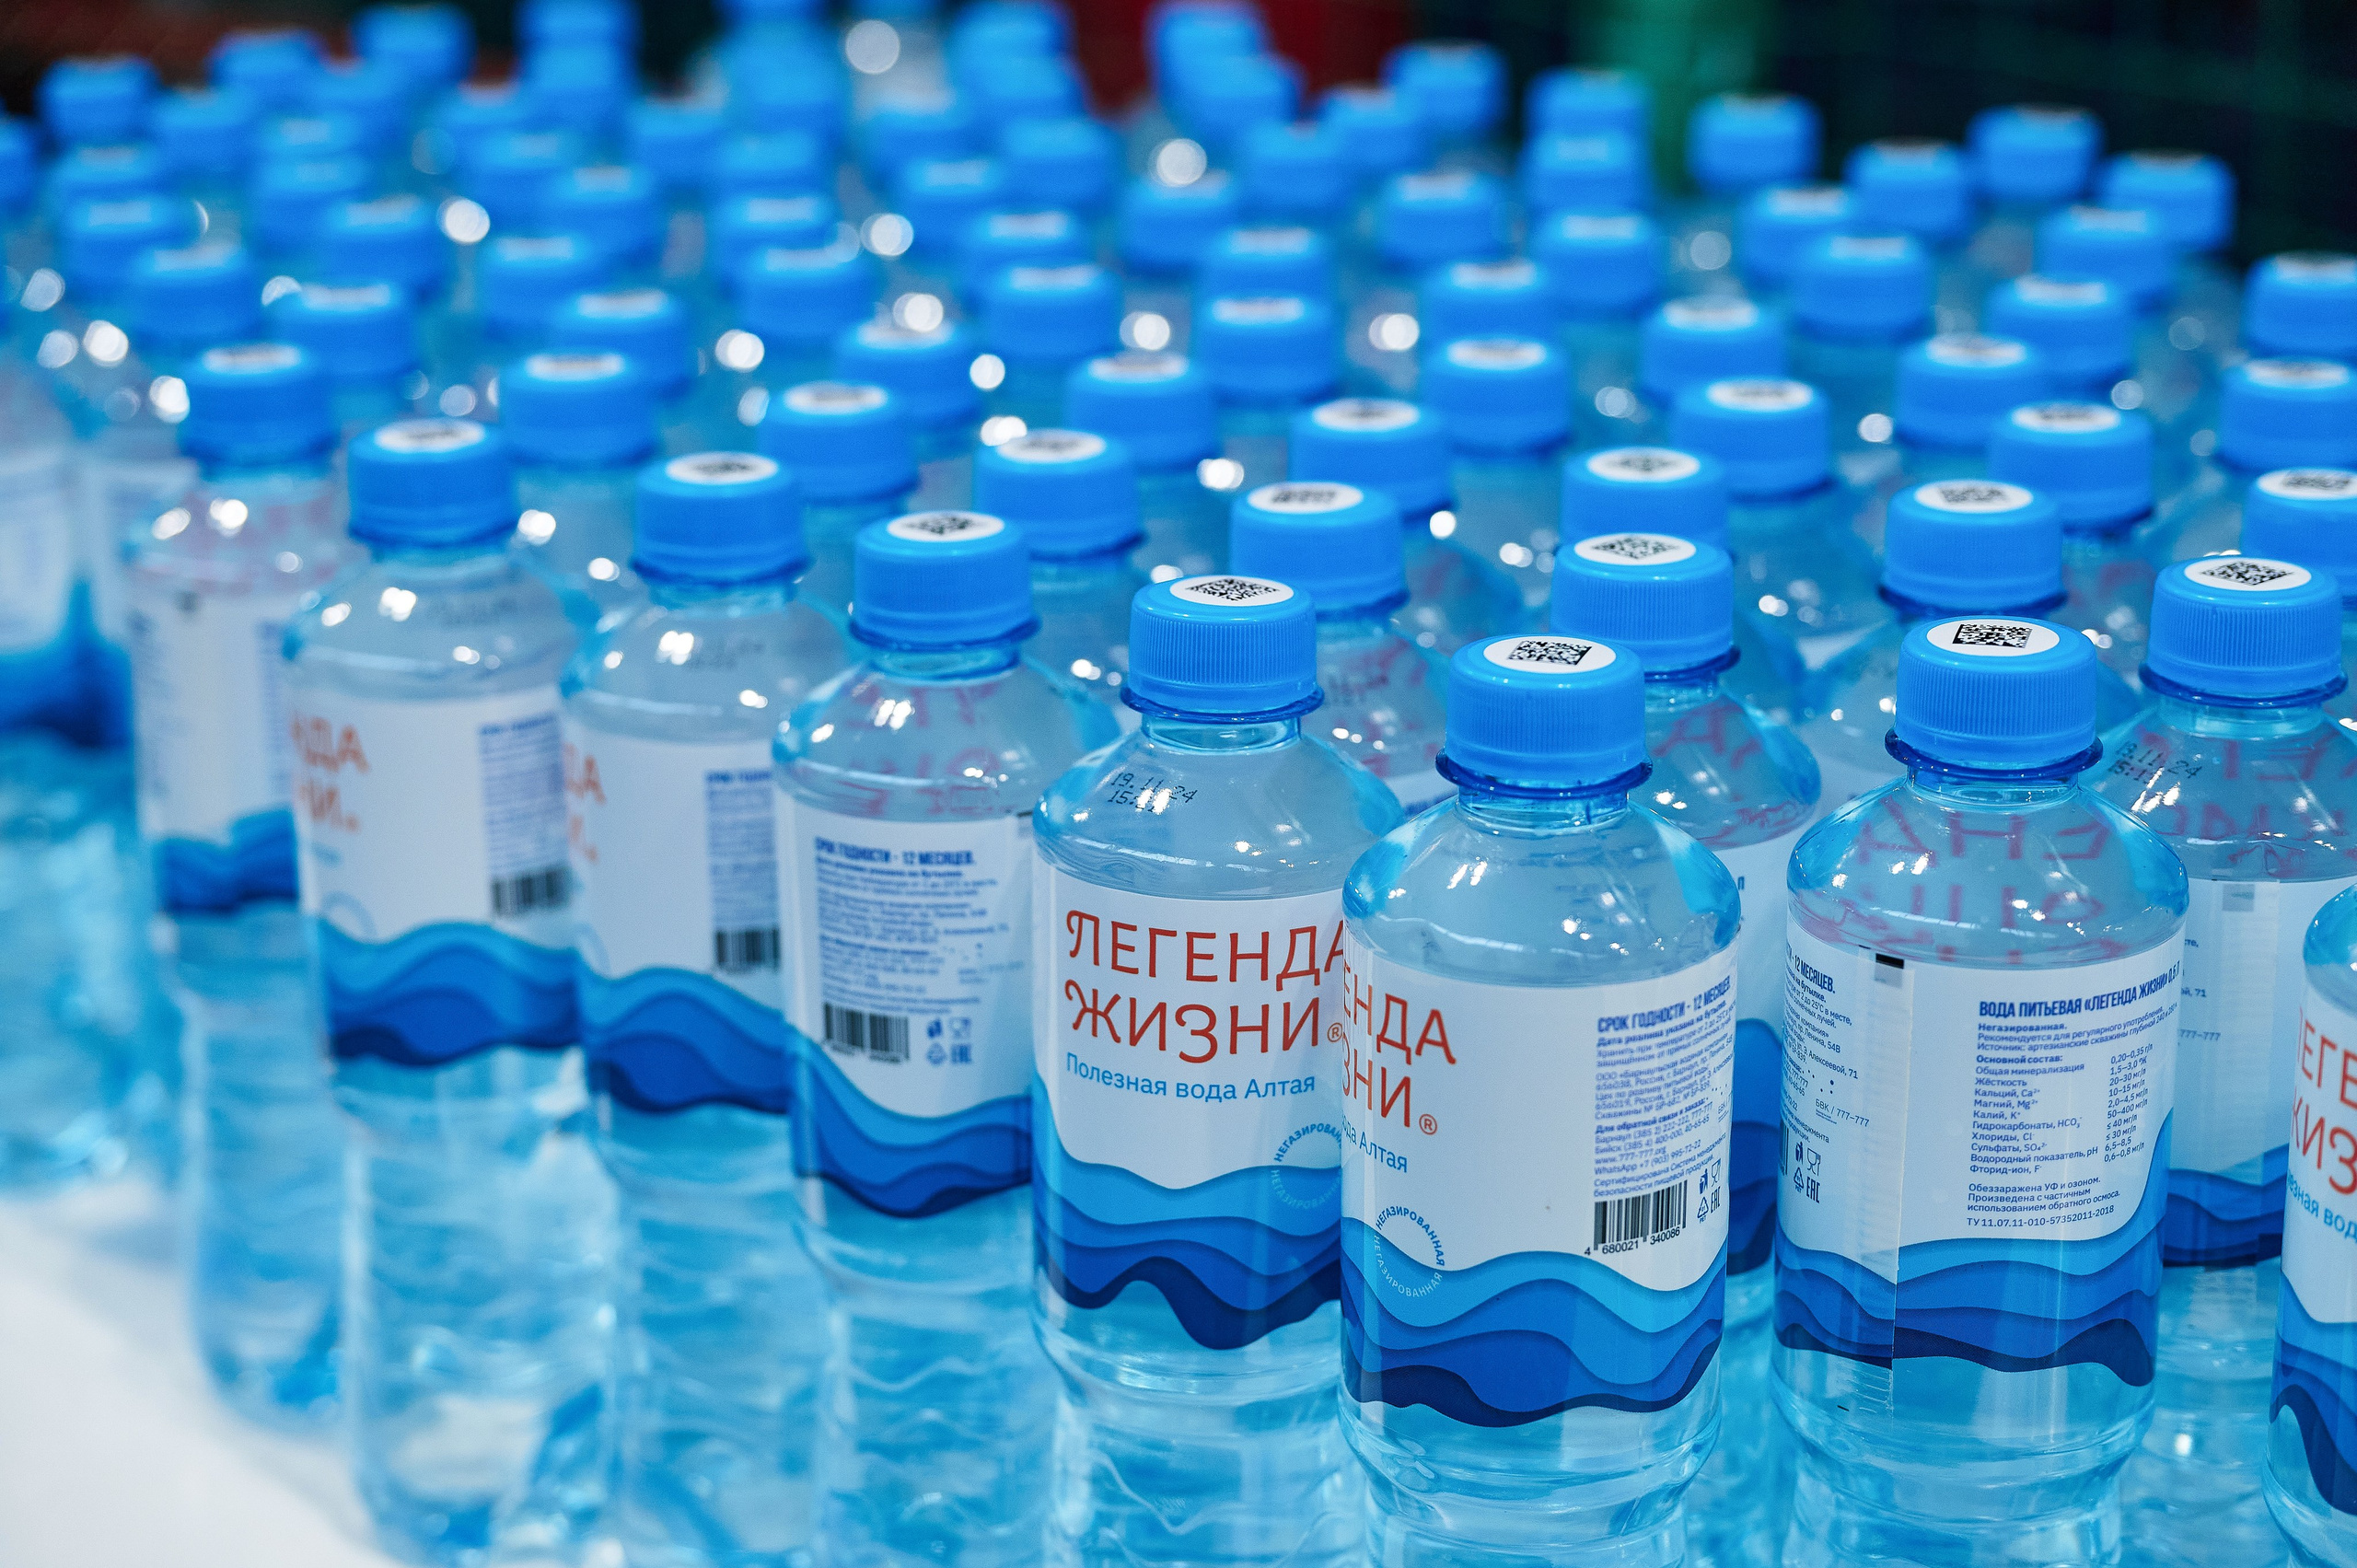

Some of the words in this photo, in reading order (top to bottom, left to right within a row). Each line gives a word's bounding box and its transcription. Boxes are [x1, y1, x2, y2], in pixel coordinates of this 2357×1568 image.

[1111, 772, 1198, 803] 19.1124
[1794, 955, 1800, 972] 12
[1801, 960, 1835, 993] МЕСЯЦЕВ.
[1801, 978, 1827, 1003] бутылке.
[2195, 987, 2207, 997] 71
[1980, 1001, 2015, 1018] ВОДА
[2018, 998, 2082, 1017] ПИТЬЕВАЯ
[2084, 986, 2137, 1012] «ЛЕГЕНДА
[1598, 1015, 1630, 1032] СРОК
[1632, 1002, 1685, 1028] ГОДНОСТИ
[1693, 994, 1701, 1010] 12
[1830, 1011, 1852, 1026] месте,
[1064, 979, 1319, 1063] ЖИЗНИ
[1801, 1016, 1829, 1038] компания»
[1817, 1014, 1836, 1028] лучей.
[1979, 1022, 2067, 1033] Негазированная.
[1597, 1037, 1622, 1047] Дата
[1625, 1029, 1664, 1044] розлива
[1666, 1019, 1694, 1036] указана
[1805, 1028, 1826, 1048] Ленина,
[1978, 1033, 2052, 1044] Рекомендуется
[2072, 1023, 2122, 1040] регулярного
[1978, 1042, 2026, 1051] Источник:
[2027, 1040, 2089, 1052] артезианские
[2090, 1031, 2129, 1045] скважины
[2130, 1019, 2156, 1038] глубиной
[1809, 1050, 1847, 1076] Алексеевой,
[1849, 1069, 1858, 1079] 71
[1976, 1054, 2026, 1064] Основной
[2026, 1055, 2062, 1063] состав:
[1975, 1066, 2009, 1075] Общая
[2011, 1063, 2084, 1074] минерализация
[2132, 1068, 2146, 1078] мг/л
[1066, 1052, 1167, 1096] Полезная
[1176, 1083, 1237, 1103] вода
[1245, 1076, 1315, 1098] Алтая
[1596, 1072, 1618, 1081] ООО
[1975, 1077, 2027, 1086] Жёсткость
[2131, 1079, 2145, 1089] мг/л
[1974, 1088, 2019, 1098] Кальций,
[2135, 1087, 2149, 1098] мг/л
[1974, 1099, 2014, 1109] Магний,
[2134, 1098, 2148, 1109] мг/л
[1973, 1110, 2007, 1120] Калий,
[2113, 1119, 2121, 1127] 40
[2123, 1114, 2137, 1124] мг/л
[1596, 1124, 1614, 1134] Для
[1617, 1117, 1657, 1131] обратной
[1972, 1121, 2056, 1132] Гидрокарбонаты,
[2111, 1130, 2121, 1138] 30
[2122, 1125, 2136, 1135] мг/л
[1971, 1132, 2019, 1142] Хлориды,
[1359, 1132, 1408, 1173] Алтая
[1970, 1143, 2022, 1153] Сульфаты,
[2131, 1142, 2144, 1153] мг/л
[1970, 1154, 2031, 1164] Водородный
[2033, 1150, 2086, 1163] показатель,
[1595, 1163, 1637, 1175] WhatsApp
[1969, 1165, 2031, 1175] Фторид-ион,
[1968, 1183, 2042, 1194] Обеззаражена
[2044, 1183, 2059, 1191] УФ
[2067, 1177, 2101, 1189] озоном.
[1968, 1193, 2035, 1202] Произведена
[2044, 1188, 2091, 1200] частичным
[1968, 1204, 2047, 1213] использованием
[2049, 1197, 2092, 1210] обратного
[2093, 1191, 2120, 1203] осмоса.
[1967, 1218, 1980, 1226] ТУ
[1982, 1205, 2115, 1227] 11.07.11-010-57352011-2018
[1376, 1206, 1445, 1266] НЕГАЗИРОВАННАЯ
[1584, 1247, 1591, 1256] 4
[1602, 1240, 1639, 1254] 680021
[1650, 1226, 1680, 1245] 340086
[1374, 1235, 1442, 1297] НЕГАЗИРОВАННАЯ
